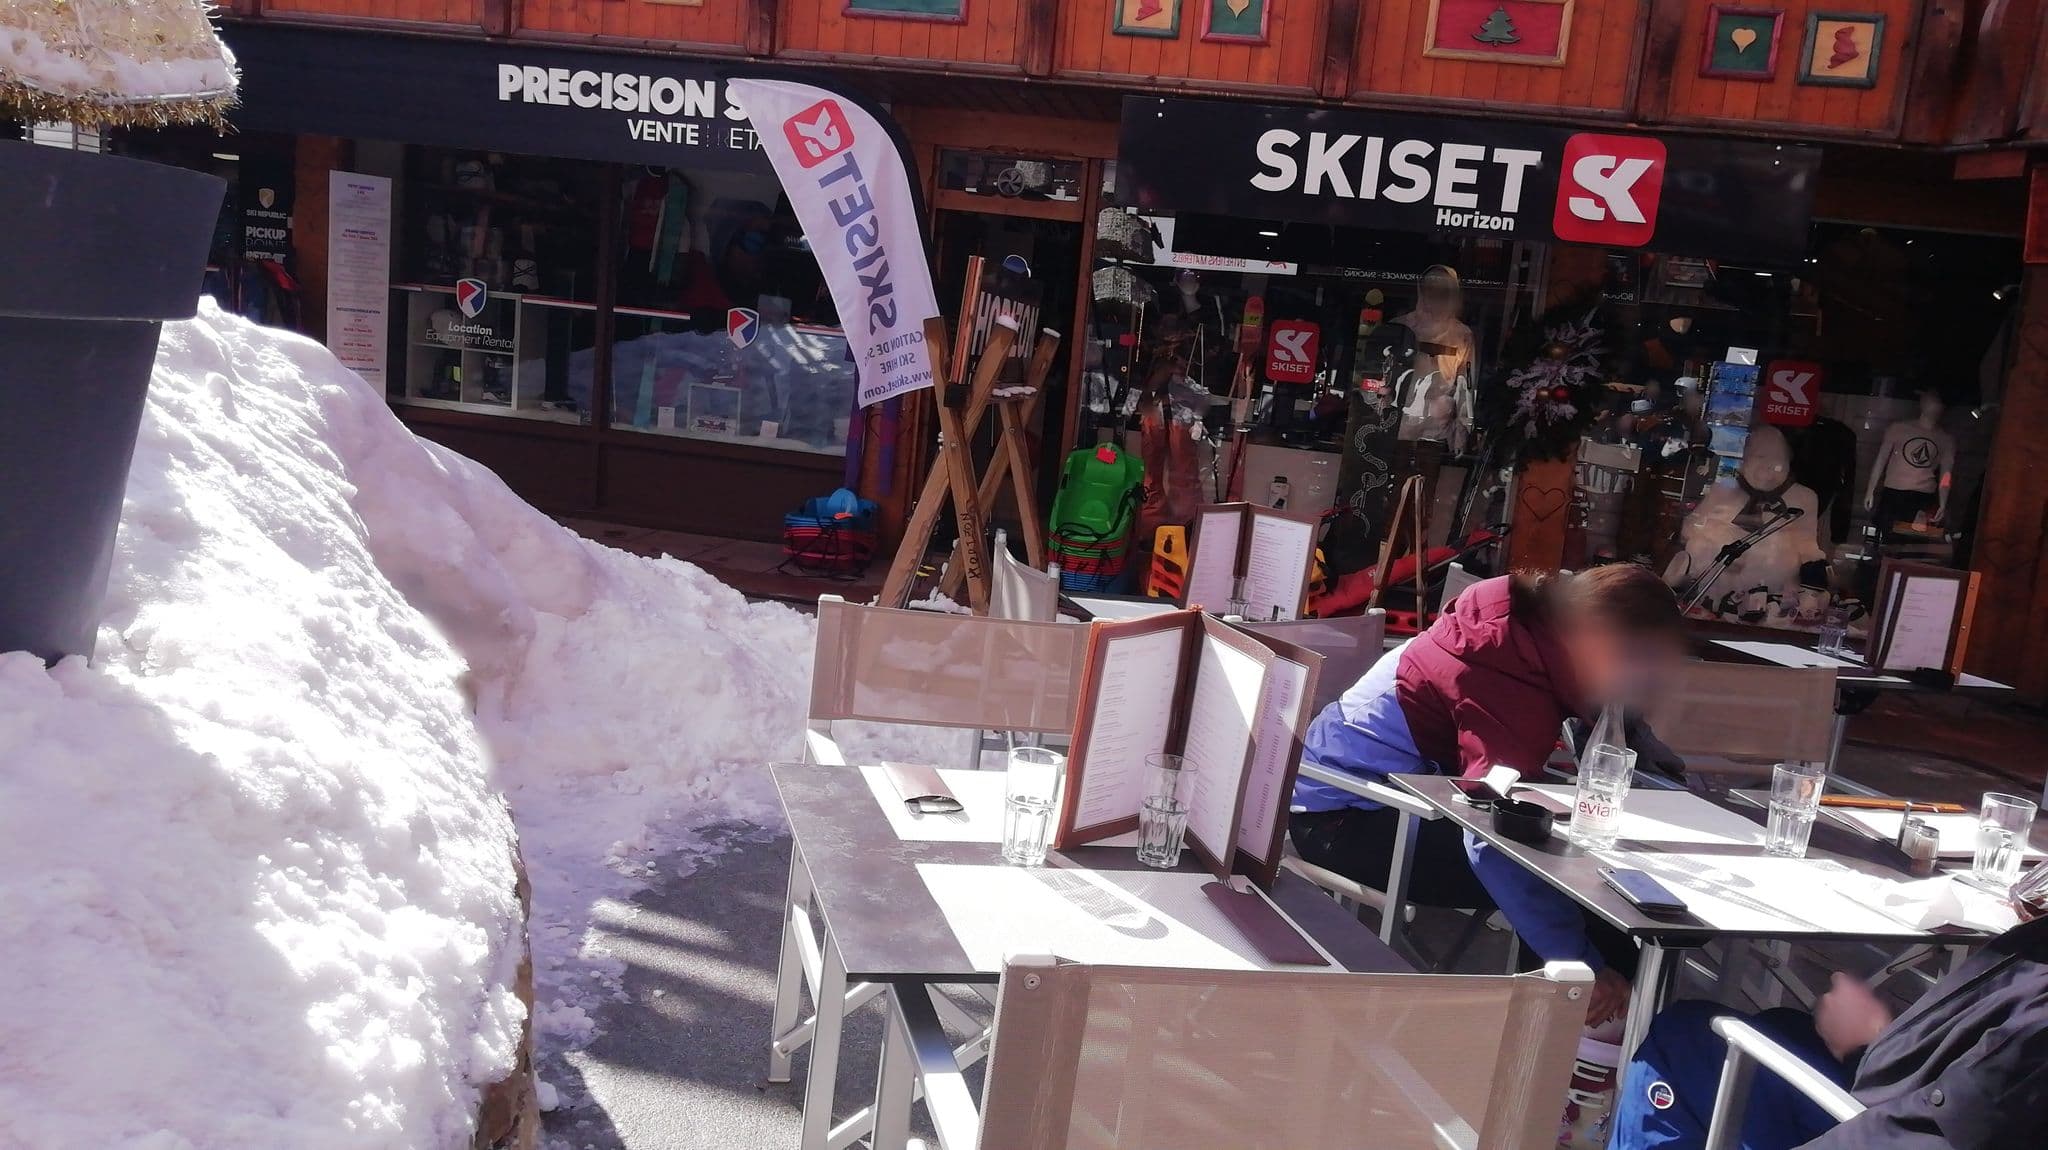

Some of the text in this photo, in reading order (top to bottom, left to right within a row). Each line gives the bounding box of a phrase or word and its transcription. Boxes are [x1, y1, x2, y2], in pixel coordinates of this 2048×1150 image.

[499, 64, 749, 121] PRECISION S
[627, 118, 699, 146] VENTE
[1249, 128, 1543, 213] SKISET
[1436, 207, 1515, 232] Horizon
[246, 225, 287, 241] PICKUP
[448, 321, 493, 336] Location
[482, 335, 515, 349] Rental
[1271, 362, 1311, 374] SKISET
[1767, 404, 1810, 417] SKISET
[1578, 801, 1619, 818] evian
